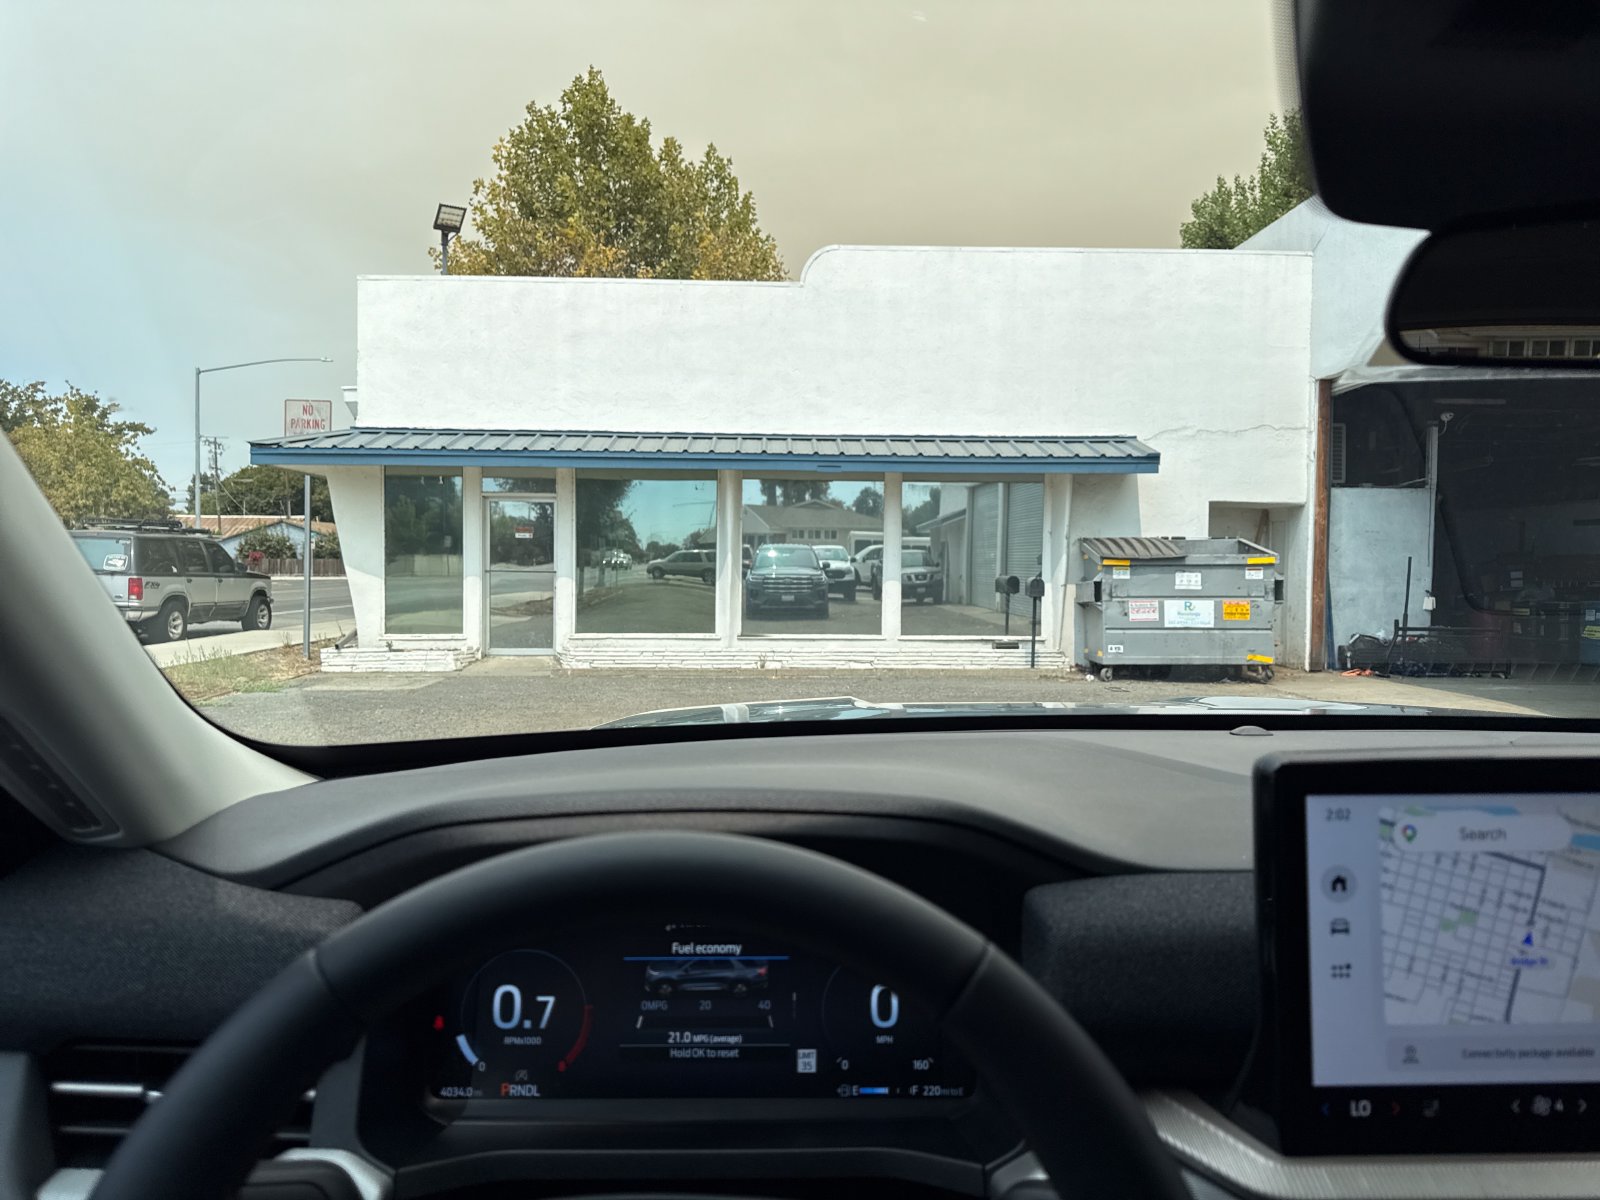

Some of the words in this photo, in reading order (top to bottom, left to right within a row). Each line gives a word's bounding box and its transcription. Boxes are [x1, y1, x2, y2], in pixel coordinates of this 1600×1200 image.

[302, 403, 314, 417] NO
[290, 418, 326, 430] PARKING
[1325, 808, 1352, 822] 2:02
[1458, 826, 1507, 842] Search
[671, 942, 695, 955] Fuel
[695, 944, 743, 957] economy
[492, 983, 556, 1030] 0.7
[699, 1000, 711, 1011] 20
[758, 1000, 771, 1011] 40
[870, 984, 899, 1029] 0
[668, 1031, 692, 1044] 21.0
[692, 1034, 709, 1044] MPG
[709, 1033, 743, 1045] (average)
[875, 1035, 894, 1044] MPH
[670, 1048, 692, 1059] Hold
[692, 1048, 705, 1058] OK
[706, 1048, 716, 1058] to
[717, 1049, 739, 1058] reset
[478, 1061, 486, 1072] 0
[841, 1059, 849, 1071] 0
[912, 1059, 930, 1071] 160
[440, 1086, 473, 1097] 4034.0
[852, 1085, 860, 1096] E
[912, 1085, 919, 1096] F
[922, 1085, 941, 1097] 220
[1350, 1099, 1372, 1118] LO
